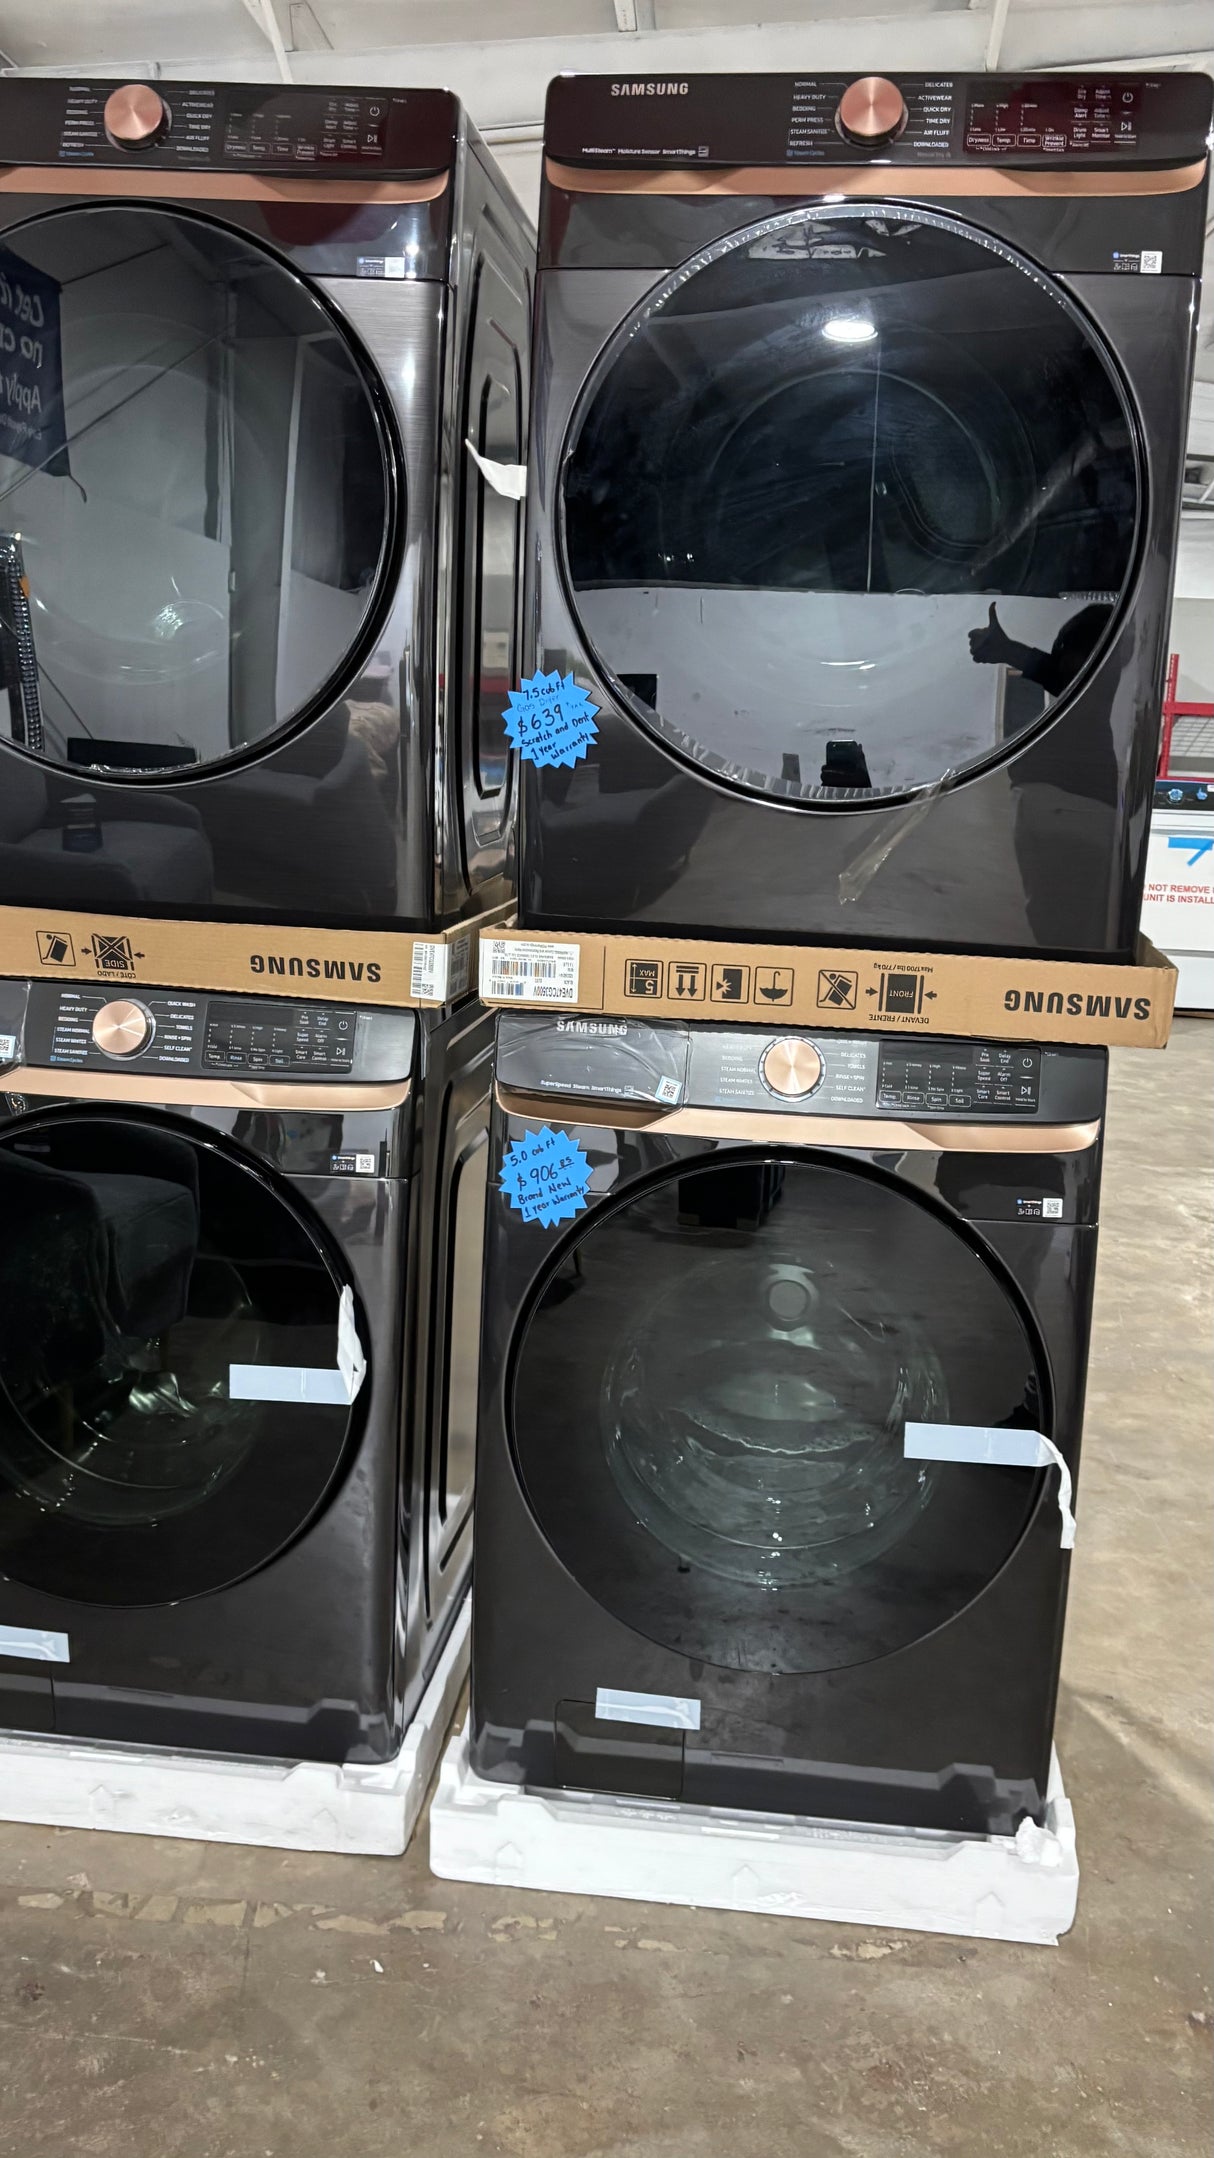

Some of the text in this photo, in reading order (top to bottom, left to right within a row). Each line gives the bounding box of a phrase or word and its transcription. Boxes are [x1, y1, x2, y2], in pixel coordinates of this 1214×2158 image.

[611, 82, 688, 96] SAMSUNG
[522, 712, 589, 747] Scratch and Dent
[531, 748, 539, 760] 1
[1170, 885, 1210, 894] REMOVE
[250, 955, 381, 982] SAMSUNG
[645, 980, 654, 993] 5
[1004, 990, 1151, 1020] SAMSUNG
[556, 1021, 628, 1036] SAMSUNG
[510, 1151, 528, 1167] 5.0
[518, 1177, 571, 1205] Brand New
[525, 1207, 531, 1218] 1
